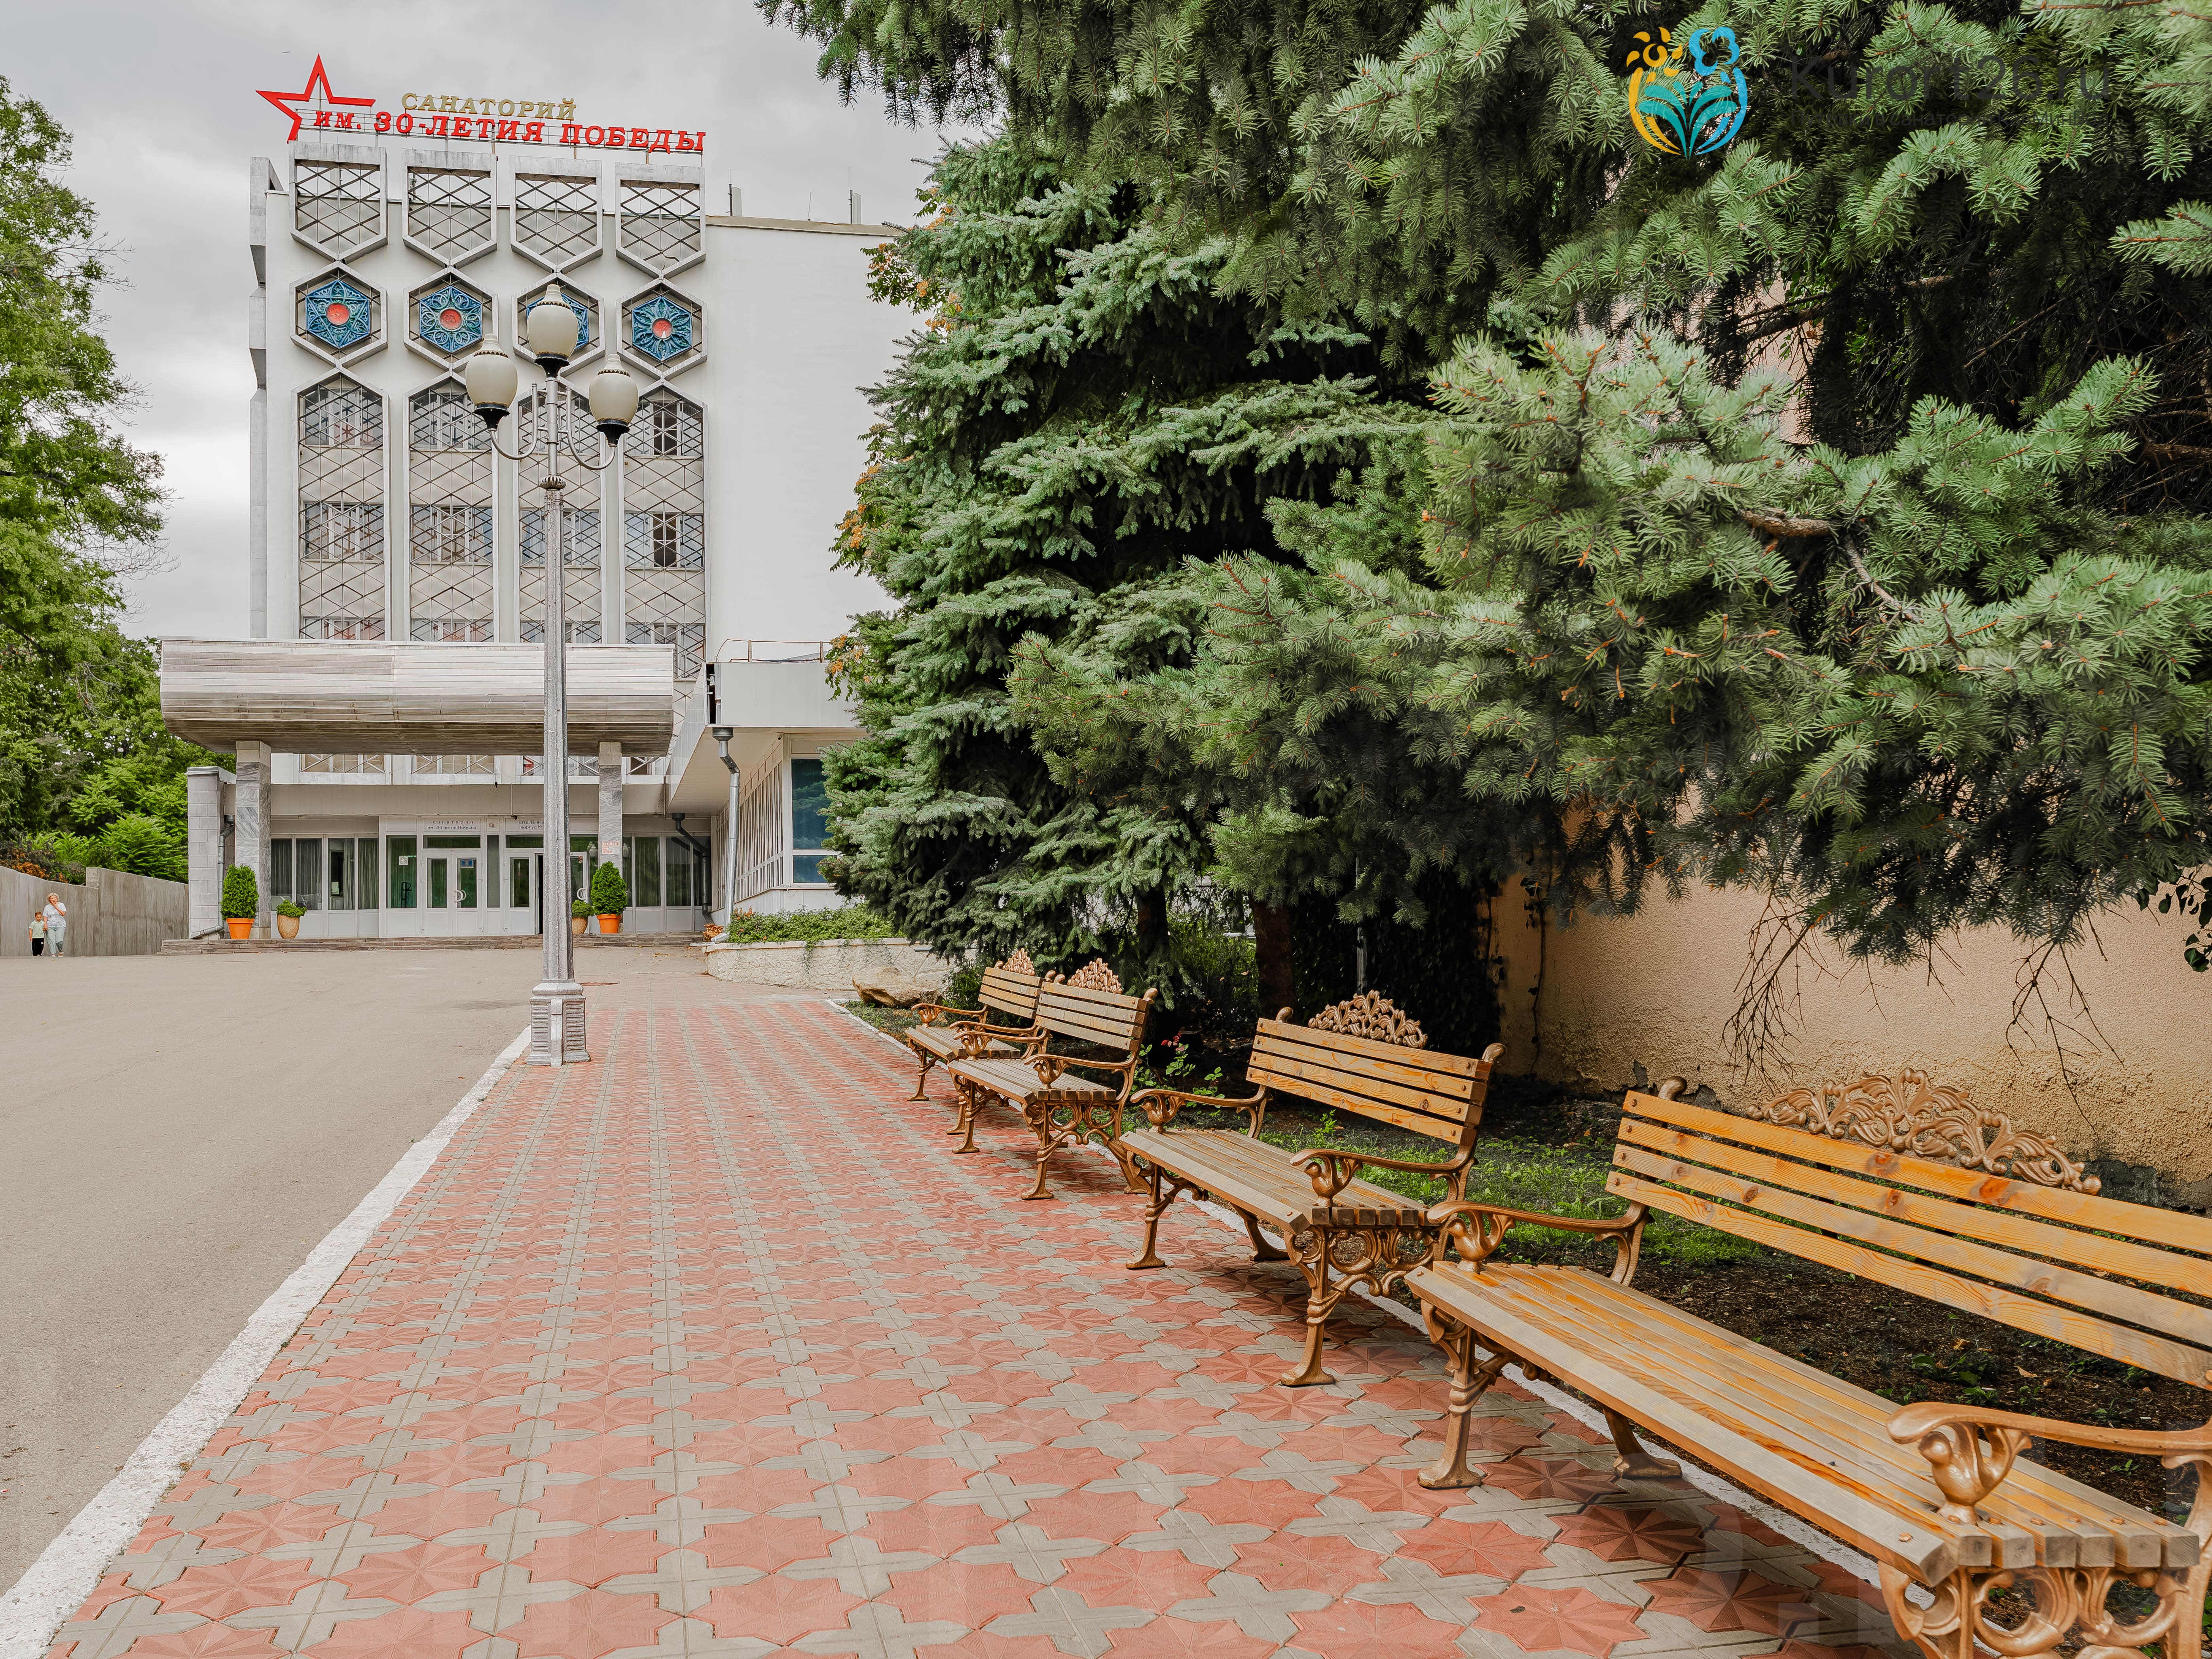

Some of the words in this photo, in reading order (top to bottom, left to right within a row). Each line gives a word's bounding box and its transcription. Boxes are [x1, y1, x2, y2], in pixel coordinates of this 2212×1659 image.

[401, 92, 577, 120] САНАТОРИЙ
[313, 111, 361, 129] ИМ.
[374, 112, 544, 142] 30-ЛЕТИЯ
[560, 123, 706, 154] ПОБЕДЫ
